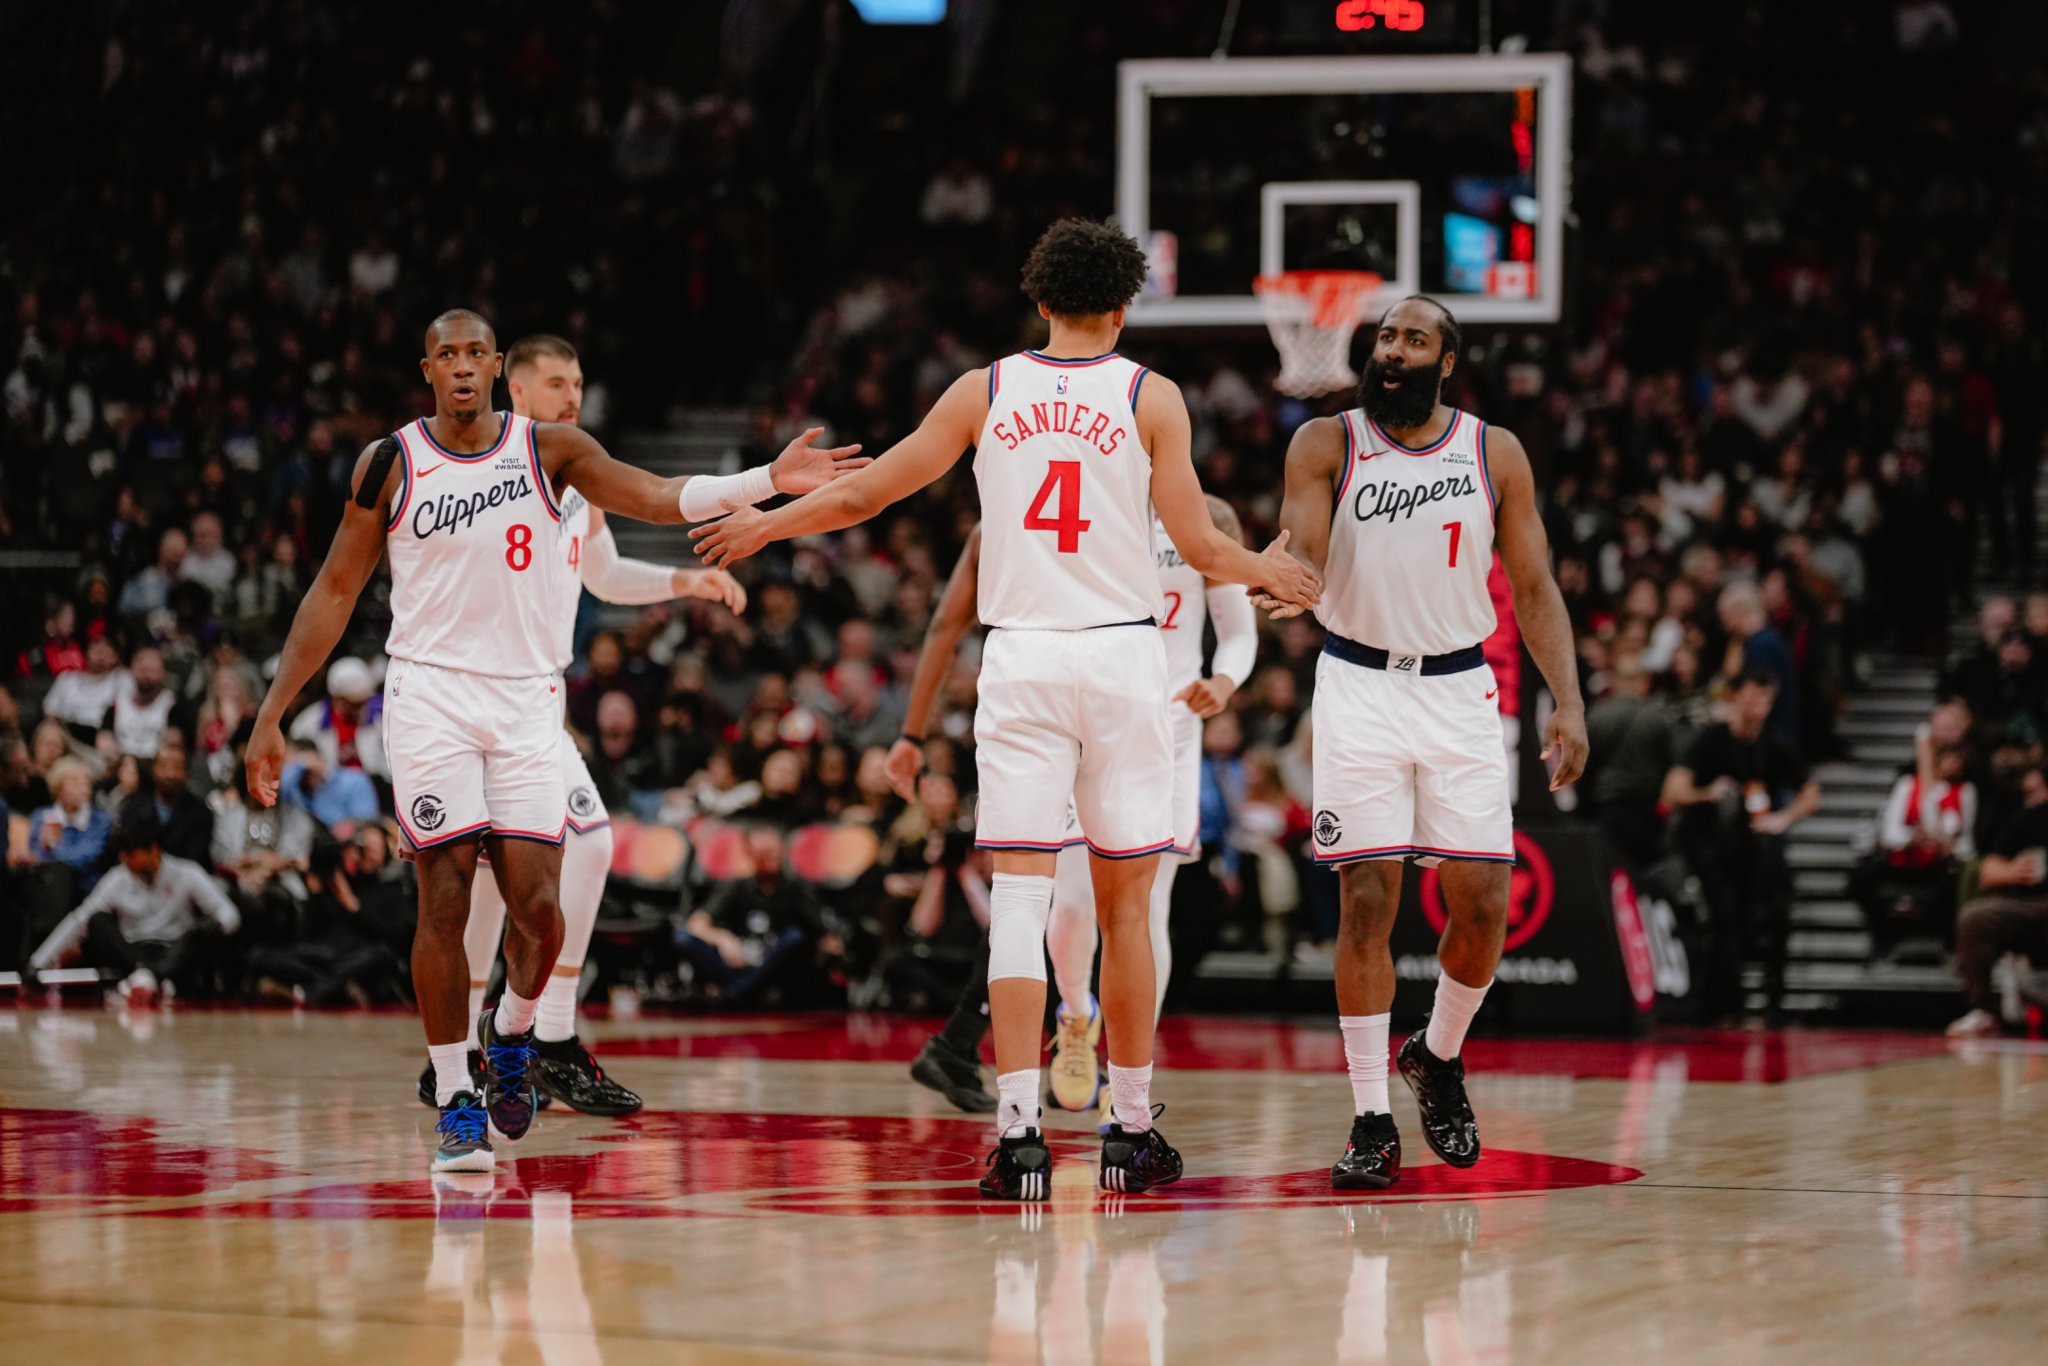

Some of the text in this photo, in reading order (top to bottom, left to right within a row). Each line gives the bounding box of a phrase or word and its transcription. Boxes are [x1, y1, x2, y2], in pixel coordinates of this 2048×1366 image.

[993, 401, 1126, 455] SANDERS
[413, 474, 532, 539] Clippers
[1023, 460, 1091, 553] 4
[1354, 474, 1476, 523] Clippers
[505, 524, 532, 572] 8
[1442, 521, 1462, 568] 1
